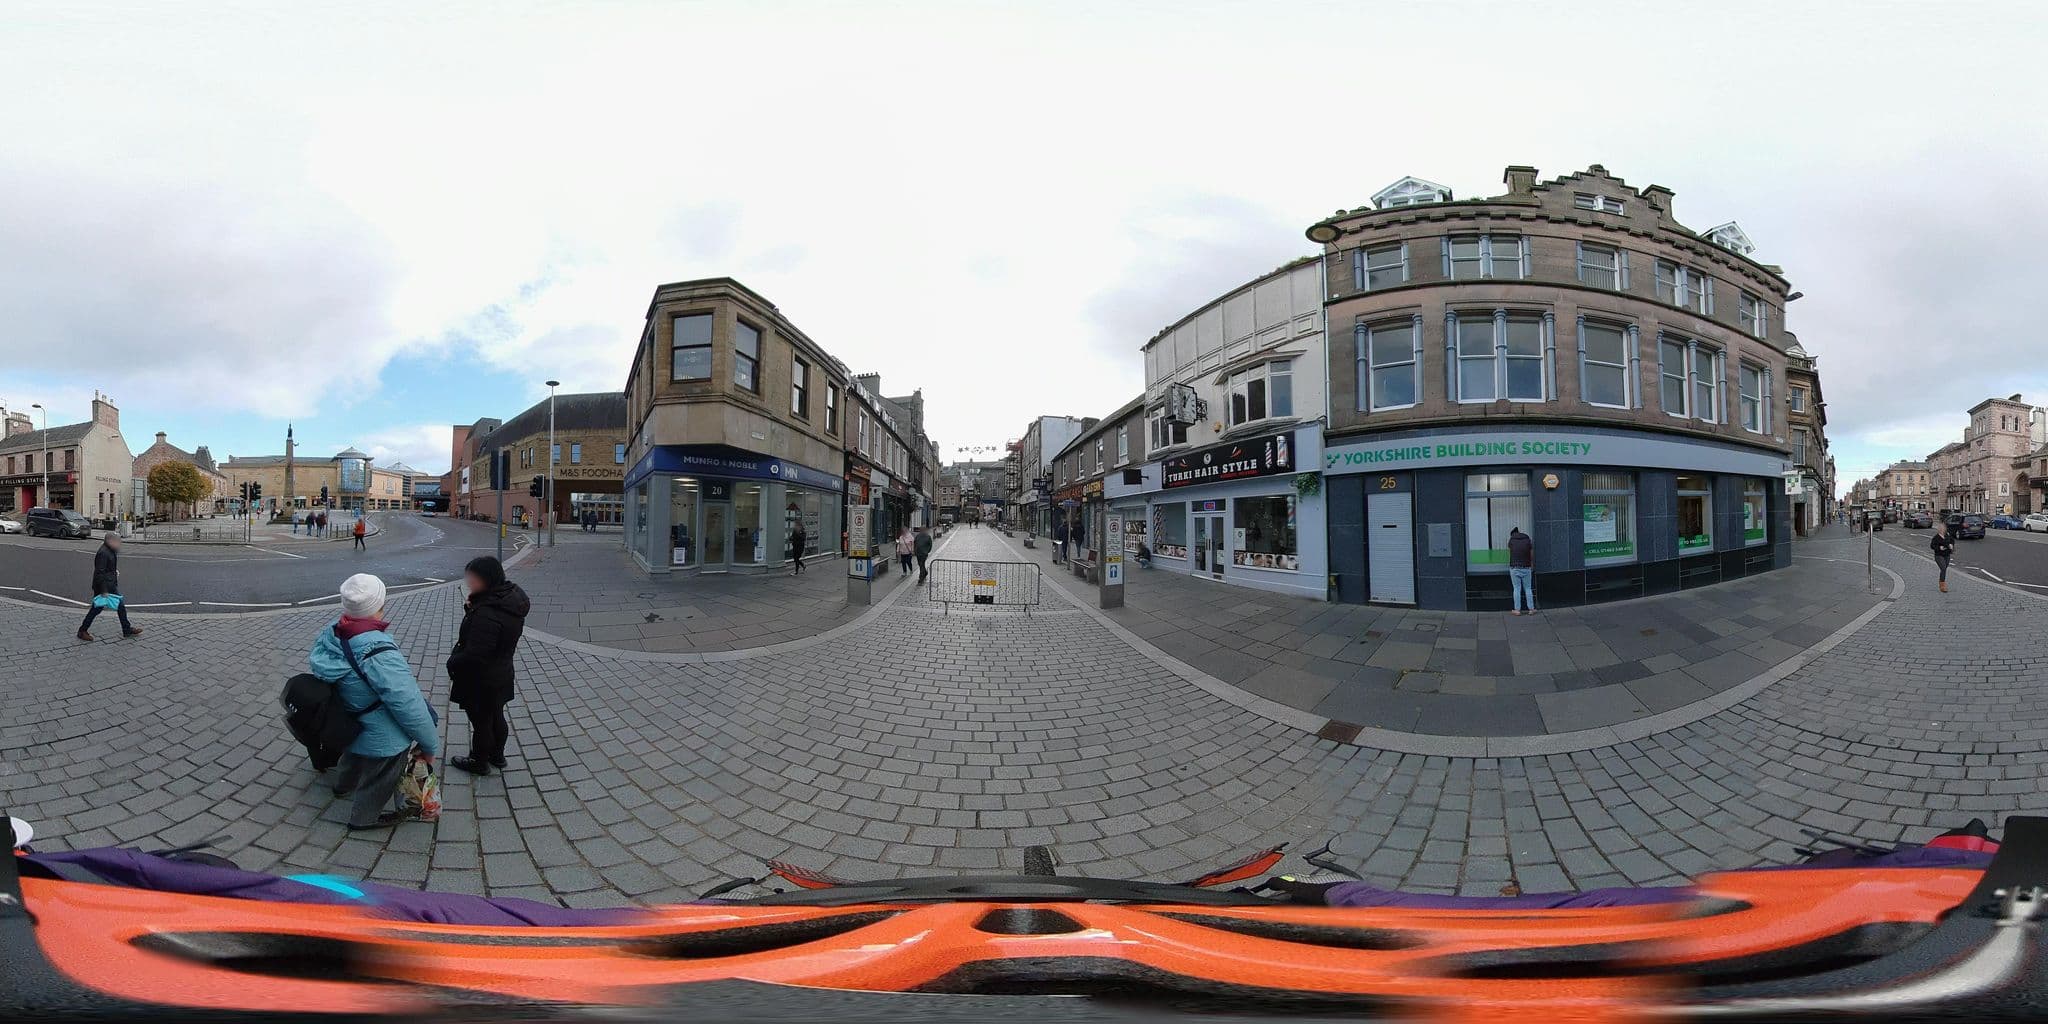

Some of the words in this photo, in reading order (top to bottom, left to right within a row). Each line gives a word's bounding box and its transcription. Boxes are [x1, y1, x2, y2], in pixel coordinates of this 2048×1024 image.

[1344, 446, 1432, 464] YORKSHIRE
[1436, 442, 1516, 458] BUILDING
[1522, 441, 1591, 456] SOCIETY
[683, 455, 720, 466] MUNRO
[728, 459, 758, 470] NOBLE
[1194, 465, 1219, 478] HAIR
[1222, 459, 1257, 473] STYLE
[560, 468, 579, 477] M&S
[784, 466, 798, 479] MN
[712, 486, 722, 495] 20
